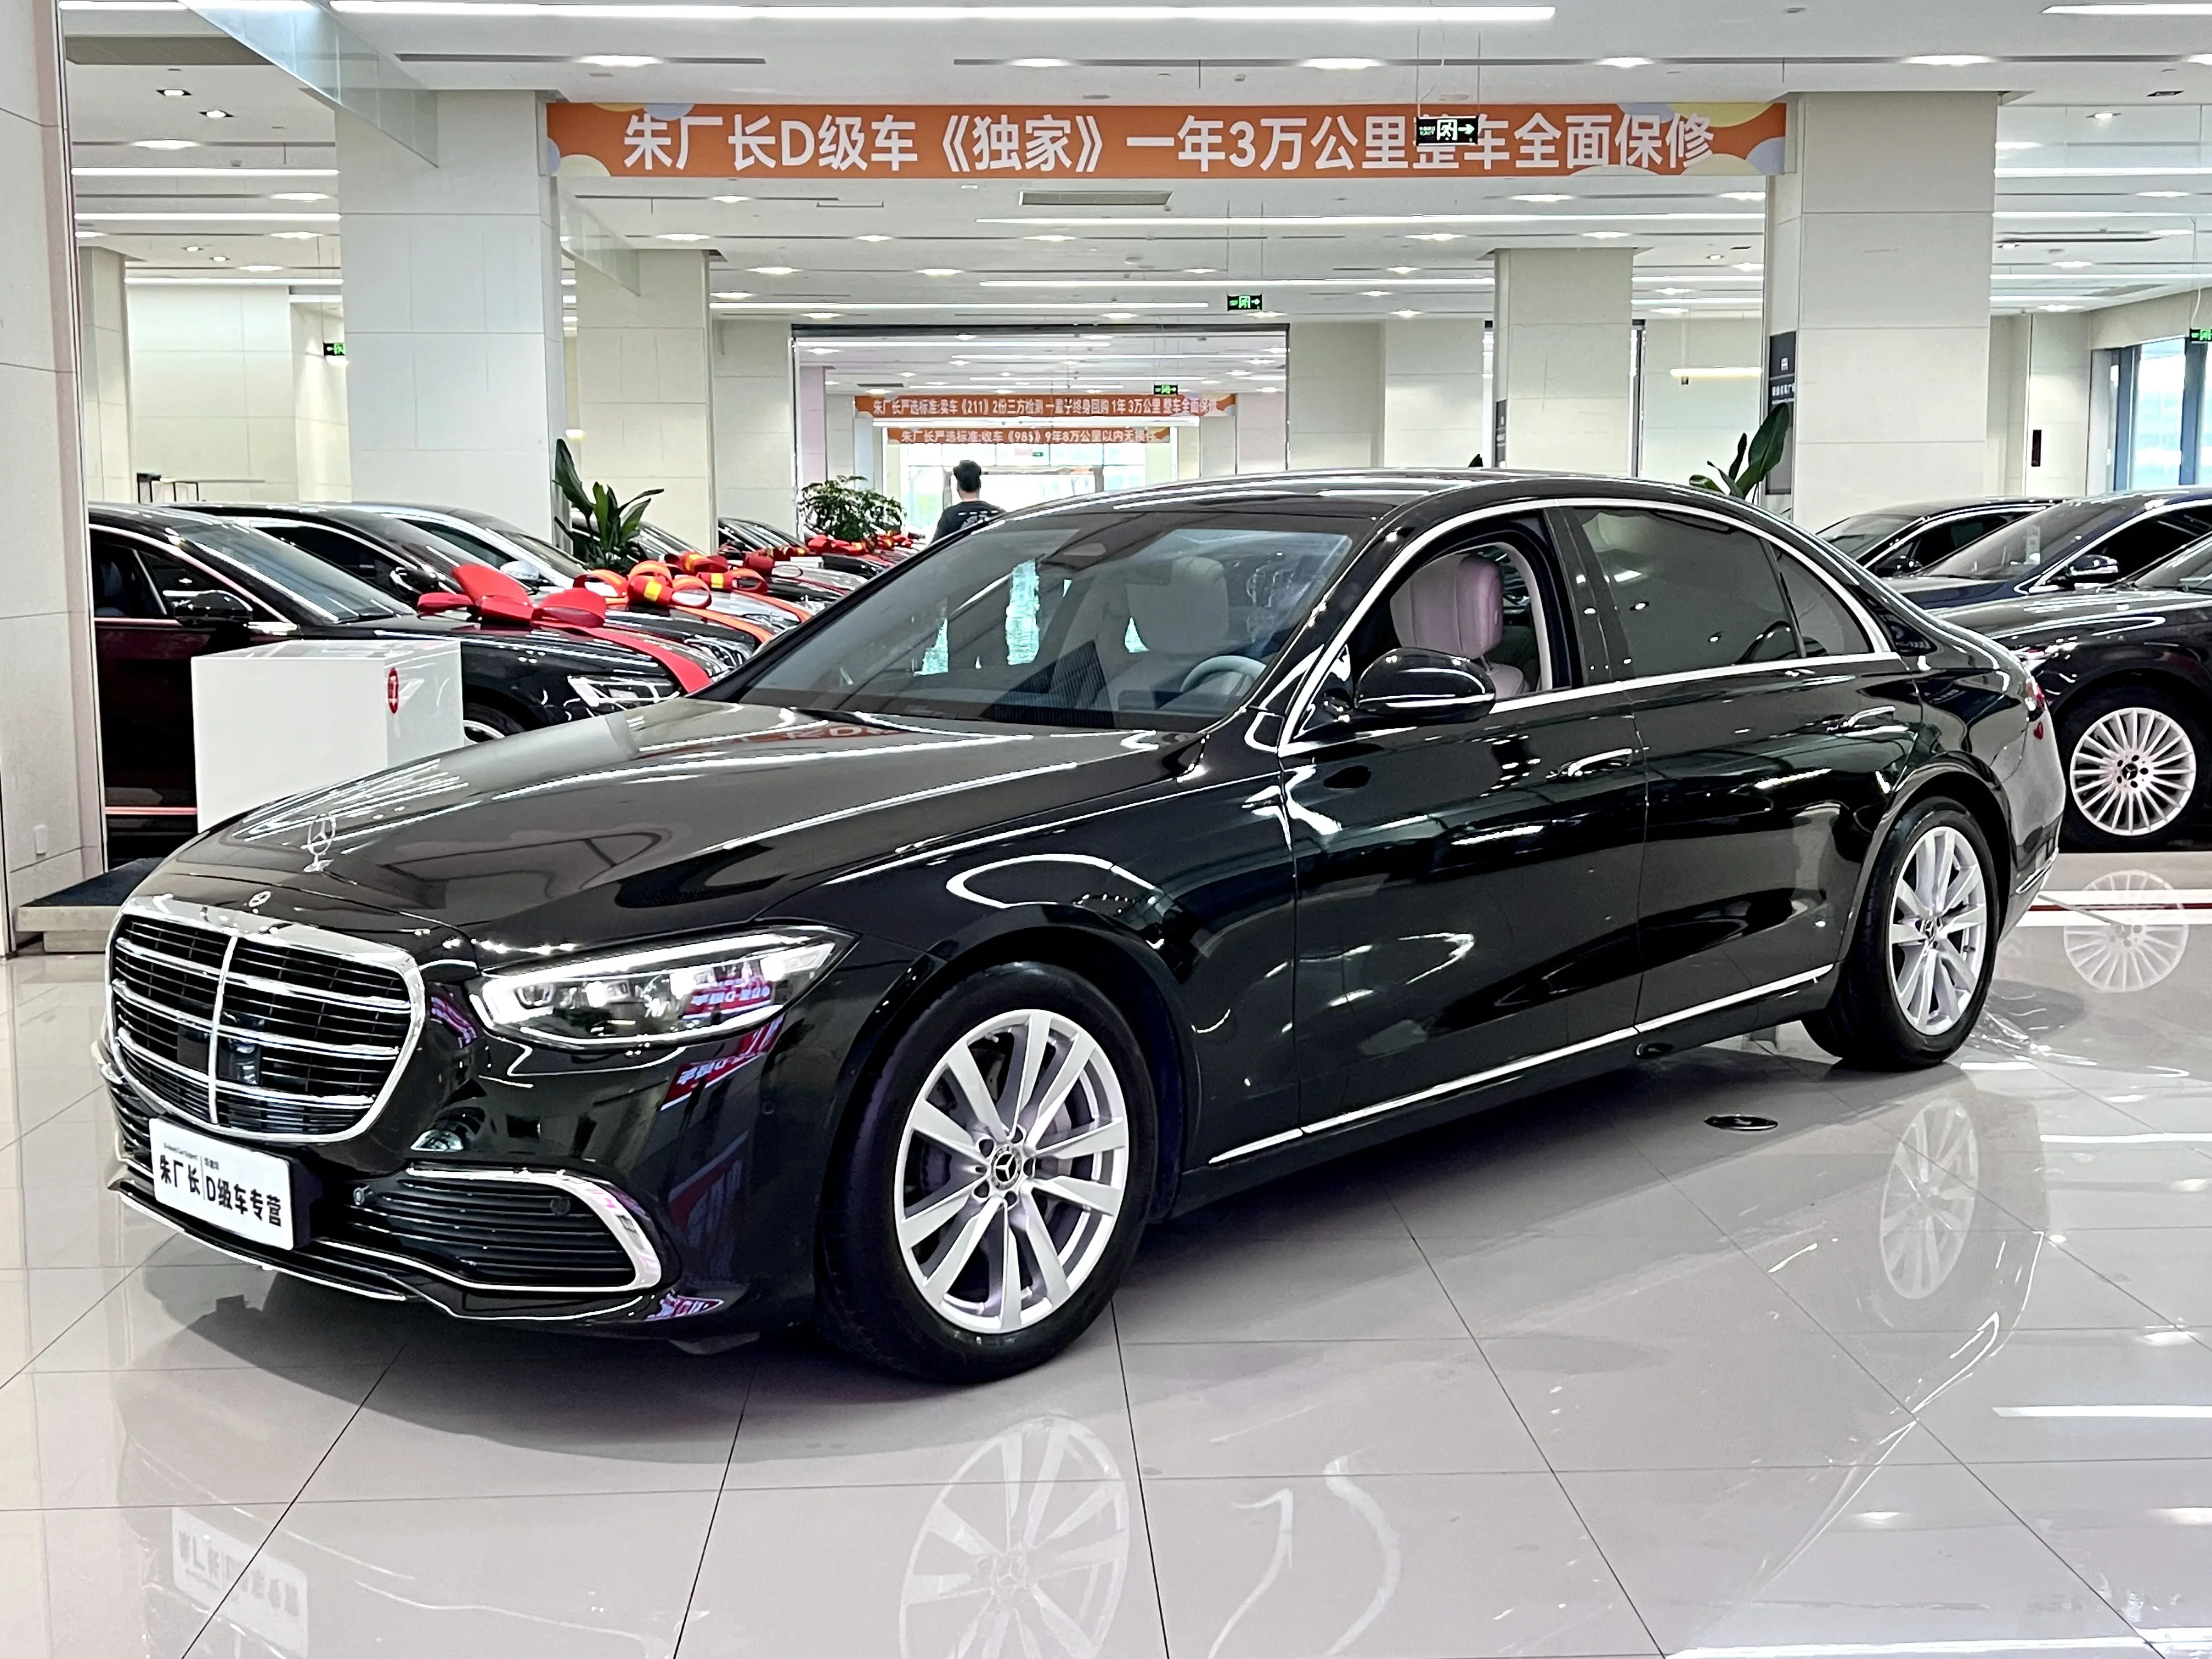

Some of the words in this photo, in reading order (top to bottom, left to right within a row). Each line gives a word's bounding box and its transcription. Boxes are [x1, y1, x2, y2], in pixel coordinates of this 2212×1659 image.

[160, 1155, 200, 1194] 朱厂长
[205, 1175, 281, 1227] D级车专营
